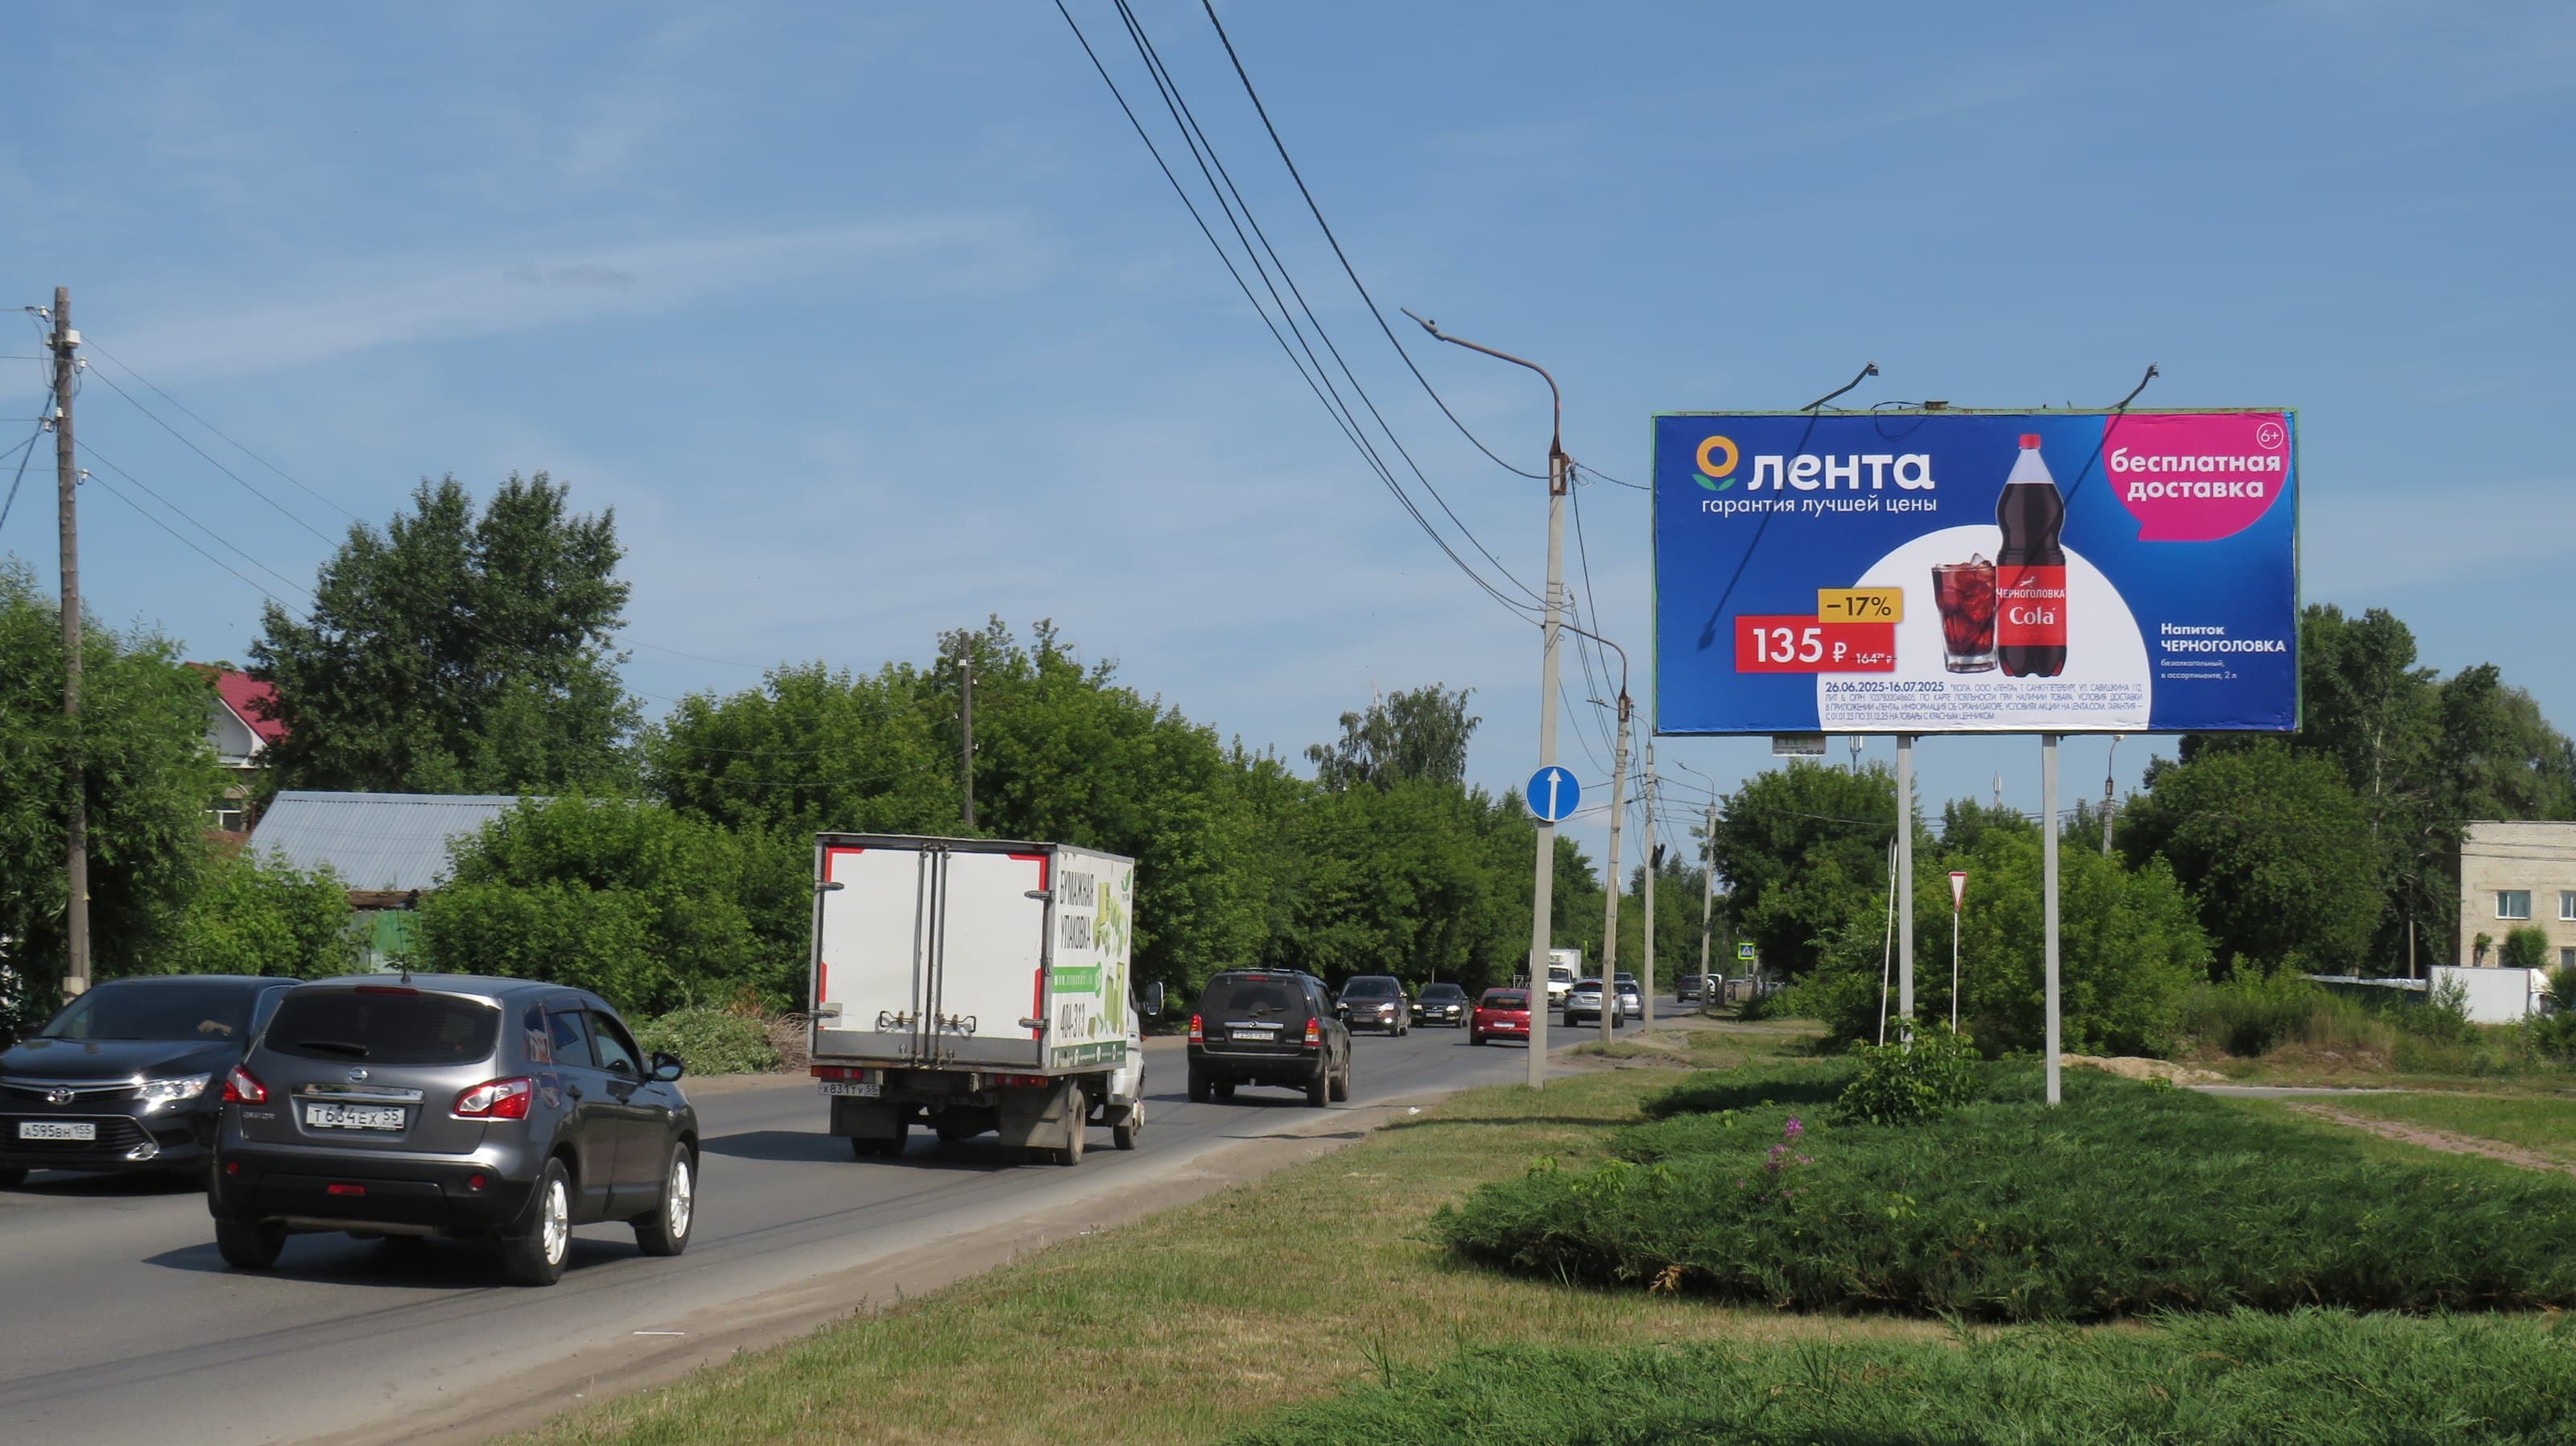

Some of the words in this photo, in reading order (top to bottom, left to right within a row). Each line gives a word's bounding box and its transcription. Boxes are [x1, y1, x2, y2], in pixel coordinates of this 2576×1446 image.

[2260, 429, 2280, 443] 6+
[2110, 447, 2281, 473] бесплатная
[1748, 454, 1935, 491] лента
[2127, 481, 2264, 502] доставка
[1703, 498, 1795, 518] гарантия
[1802, 494, 1879, 518] лучшей
[1886, 497, 1937, 514] цены
[1996, 588, 2066, 599] ЧЕРНОГОЛОВКА
[2009, 606, 2055, 625] Cola
[2161, 623, 2225, 635] Напиток
[1752, 627, 1823, 663] 135
[2161, 640, 2286, 652] ЧЕРНОГОЛОВКА
[1825, 681, 1944, 692] 26.06.2025-16.07.2025
[1060, 870, 1094, 907] БУМАЖНАЯ
[1060, 915, 1090, 950] УПАКОВКА
[1060, 1002, 1085, 1039] 404-313
